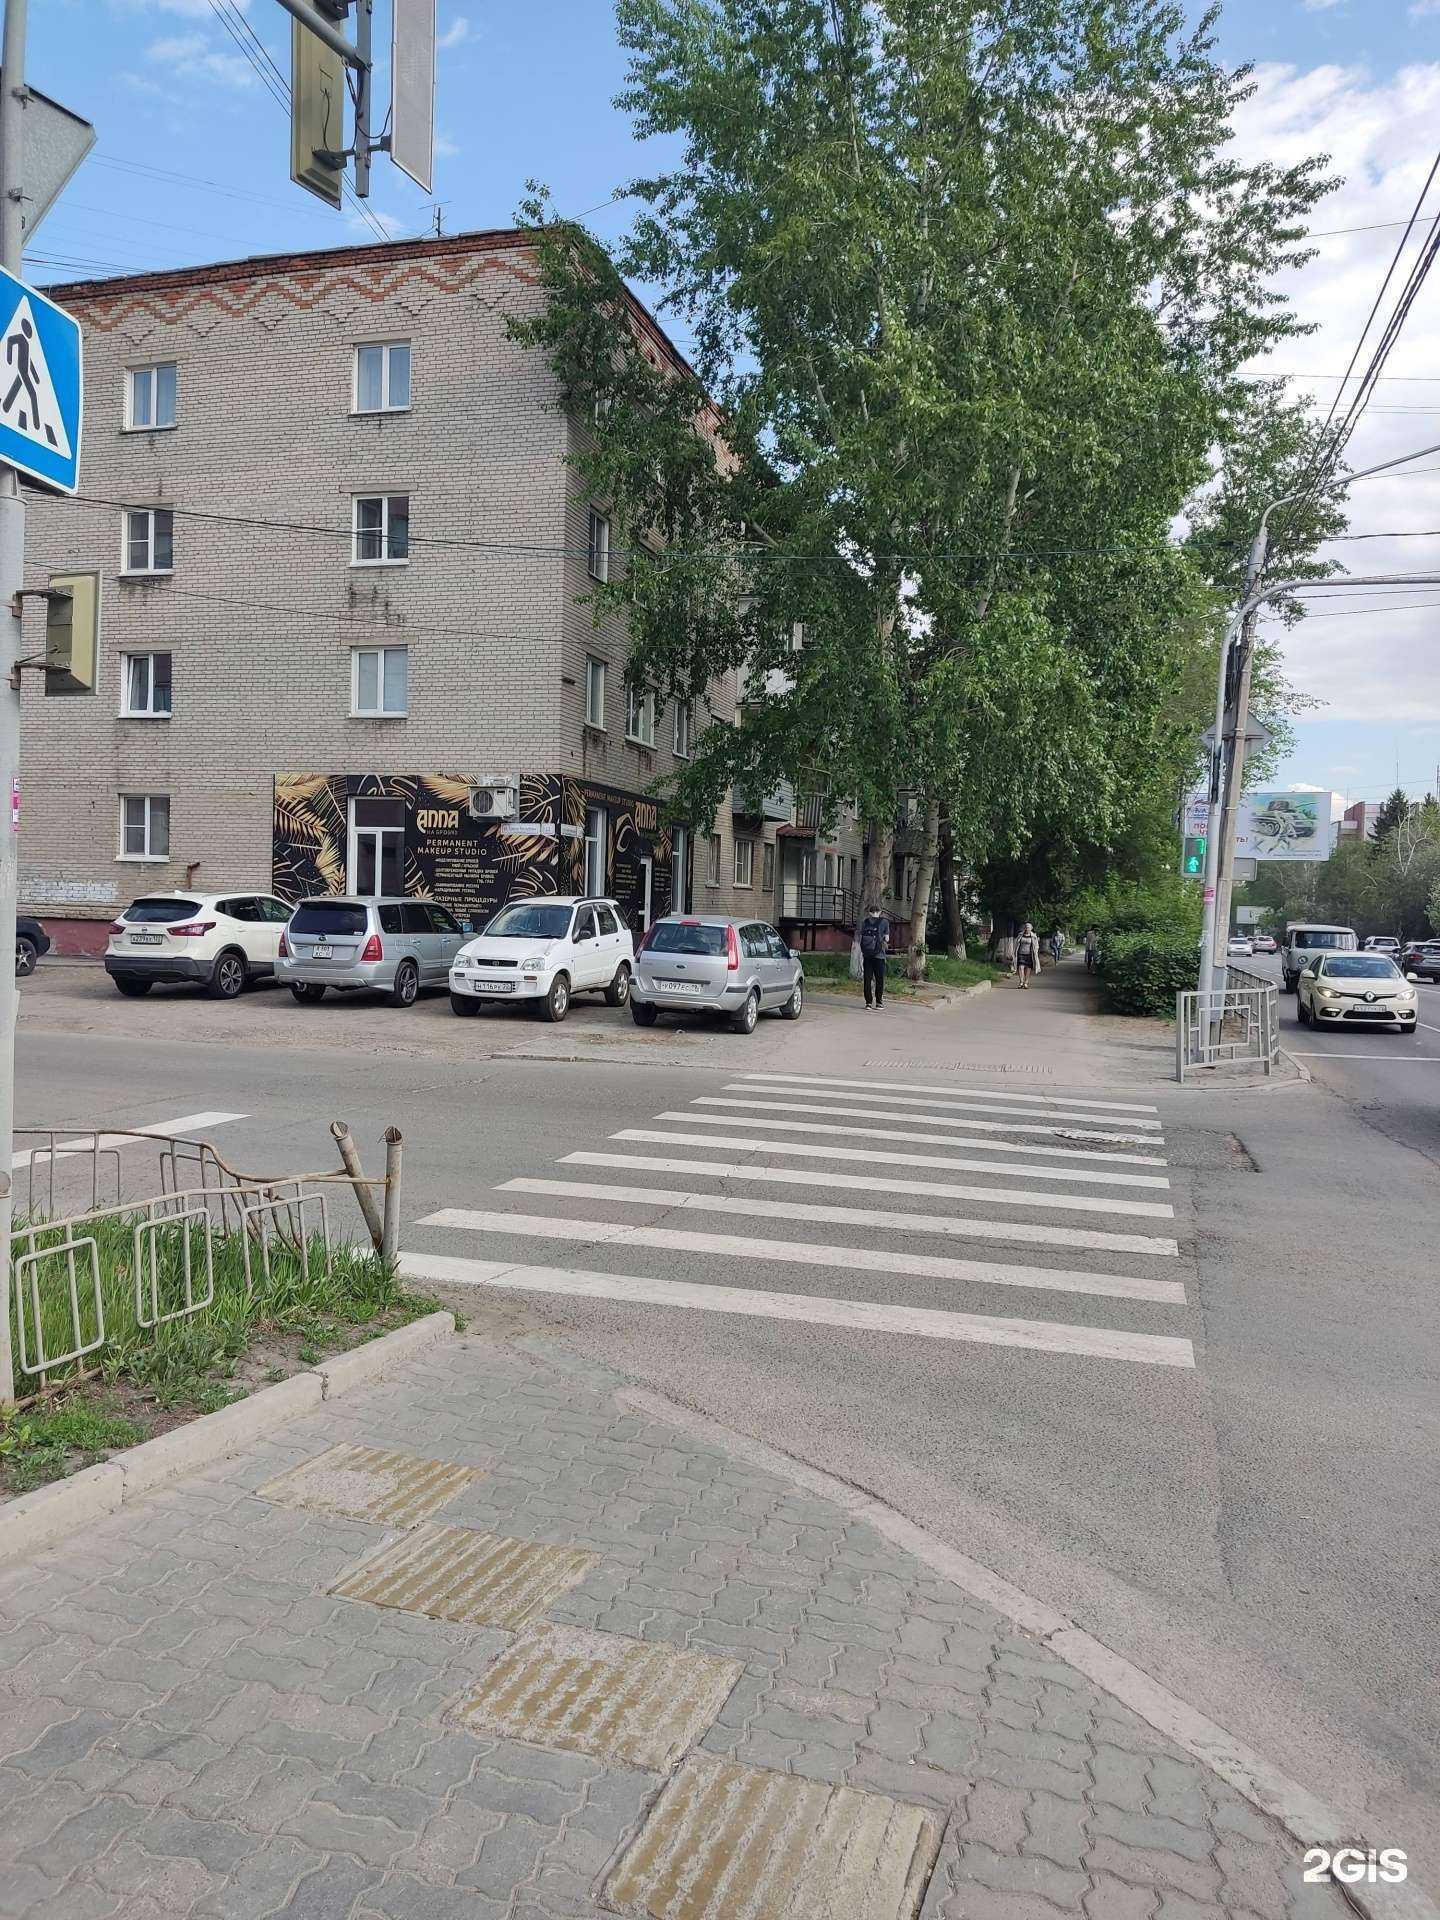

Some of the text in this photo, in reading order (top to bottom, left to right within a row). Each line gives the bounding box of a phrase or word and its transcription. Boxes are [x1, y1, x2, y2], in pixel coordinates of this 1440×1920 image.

[426, 839, 479, 847] PERMANENT
[417, 847, 488, 856] MAKEUP STUDIO
